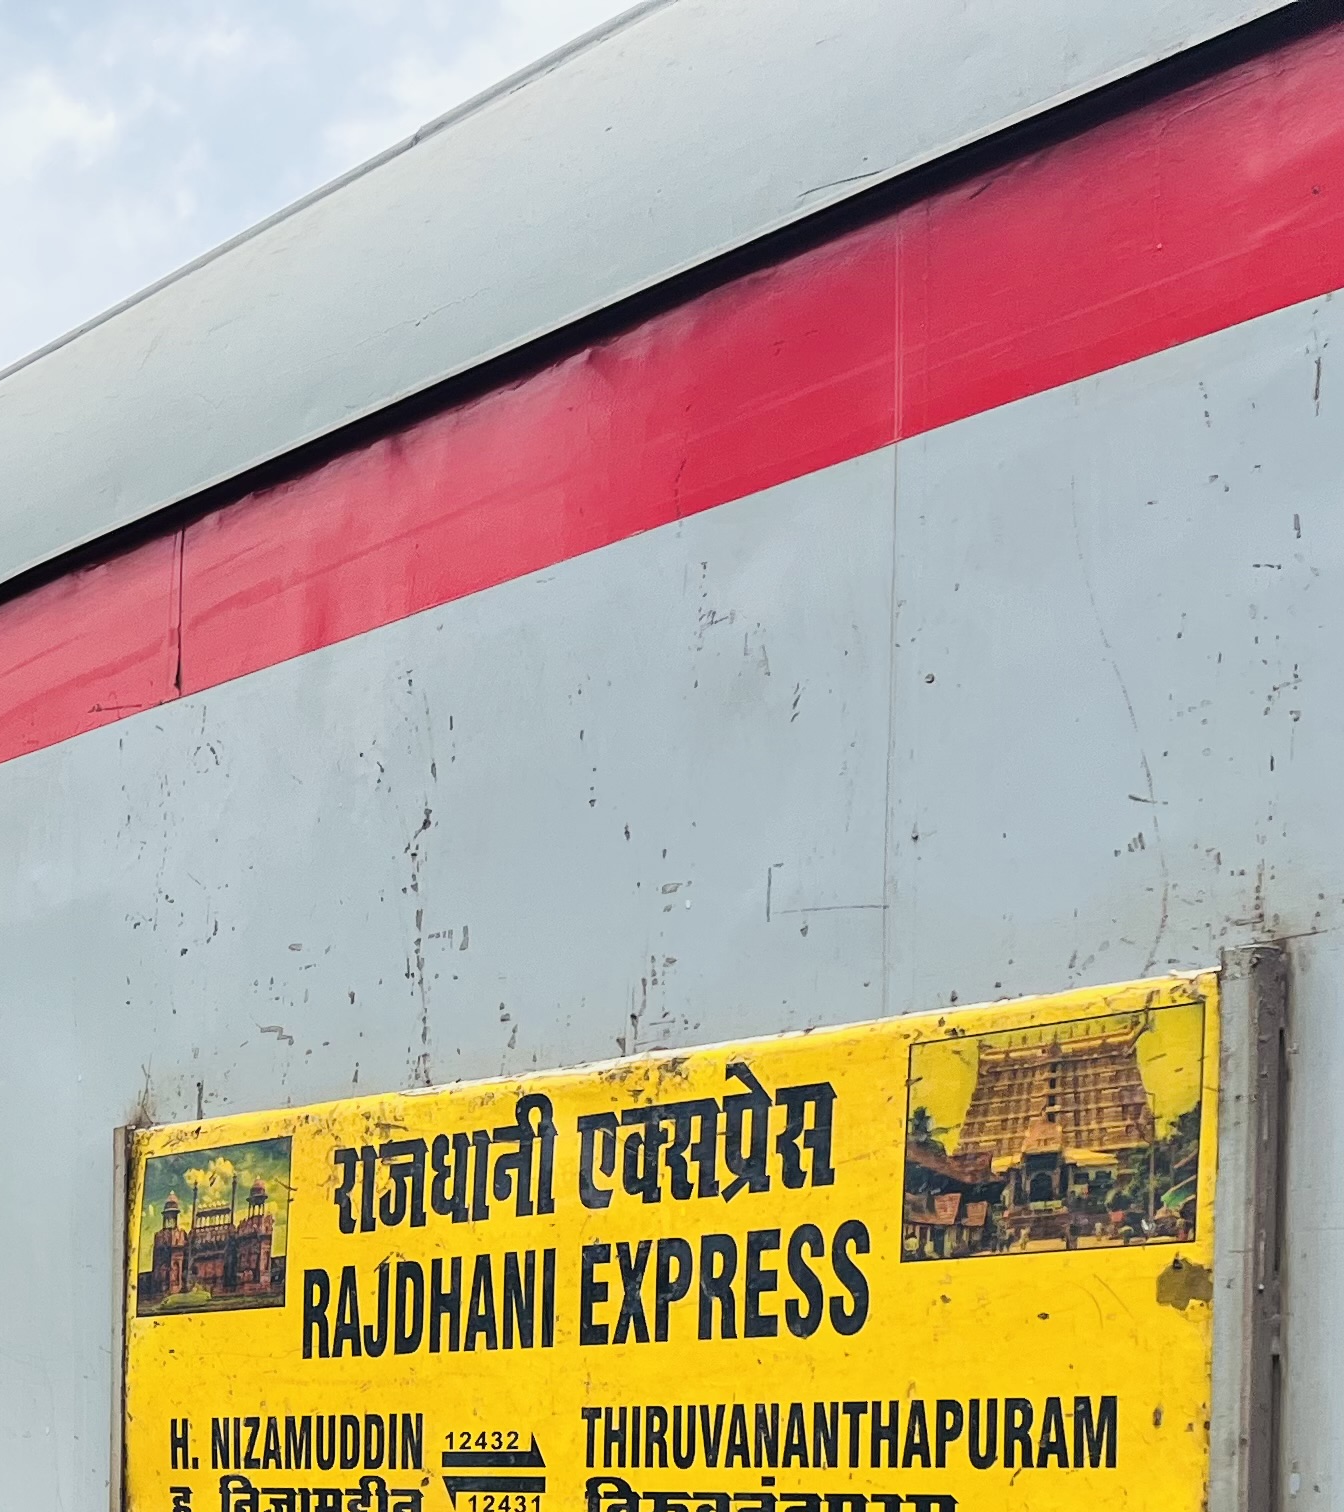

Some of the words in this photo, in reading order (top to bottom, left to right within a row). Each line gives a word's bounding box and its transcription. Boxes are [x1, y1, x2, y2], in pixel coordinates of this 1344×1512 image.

[334, 1092, 558, 1235] राजधानी
[577, 1062, 839, 1209] एक्सप्रेस
[302, 1247, 557, 1360] RAJDHANI
[579, 1219, 872, 1346] EXPRESS
[170, 1417, 200, 1470] H.
[211, 1412, 424, 1471] NIZAMUDDIN
[445, 1431, 519, 1450] 12432
[581, 1395, 1118, 1471] THIRUVANANTHAPURAM
